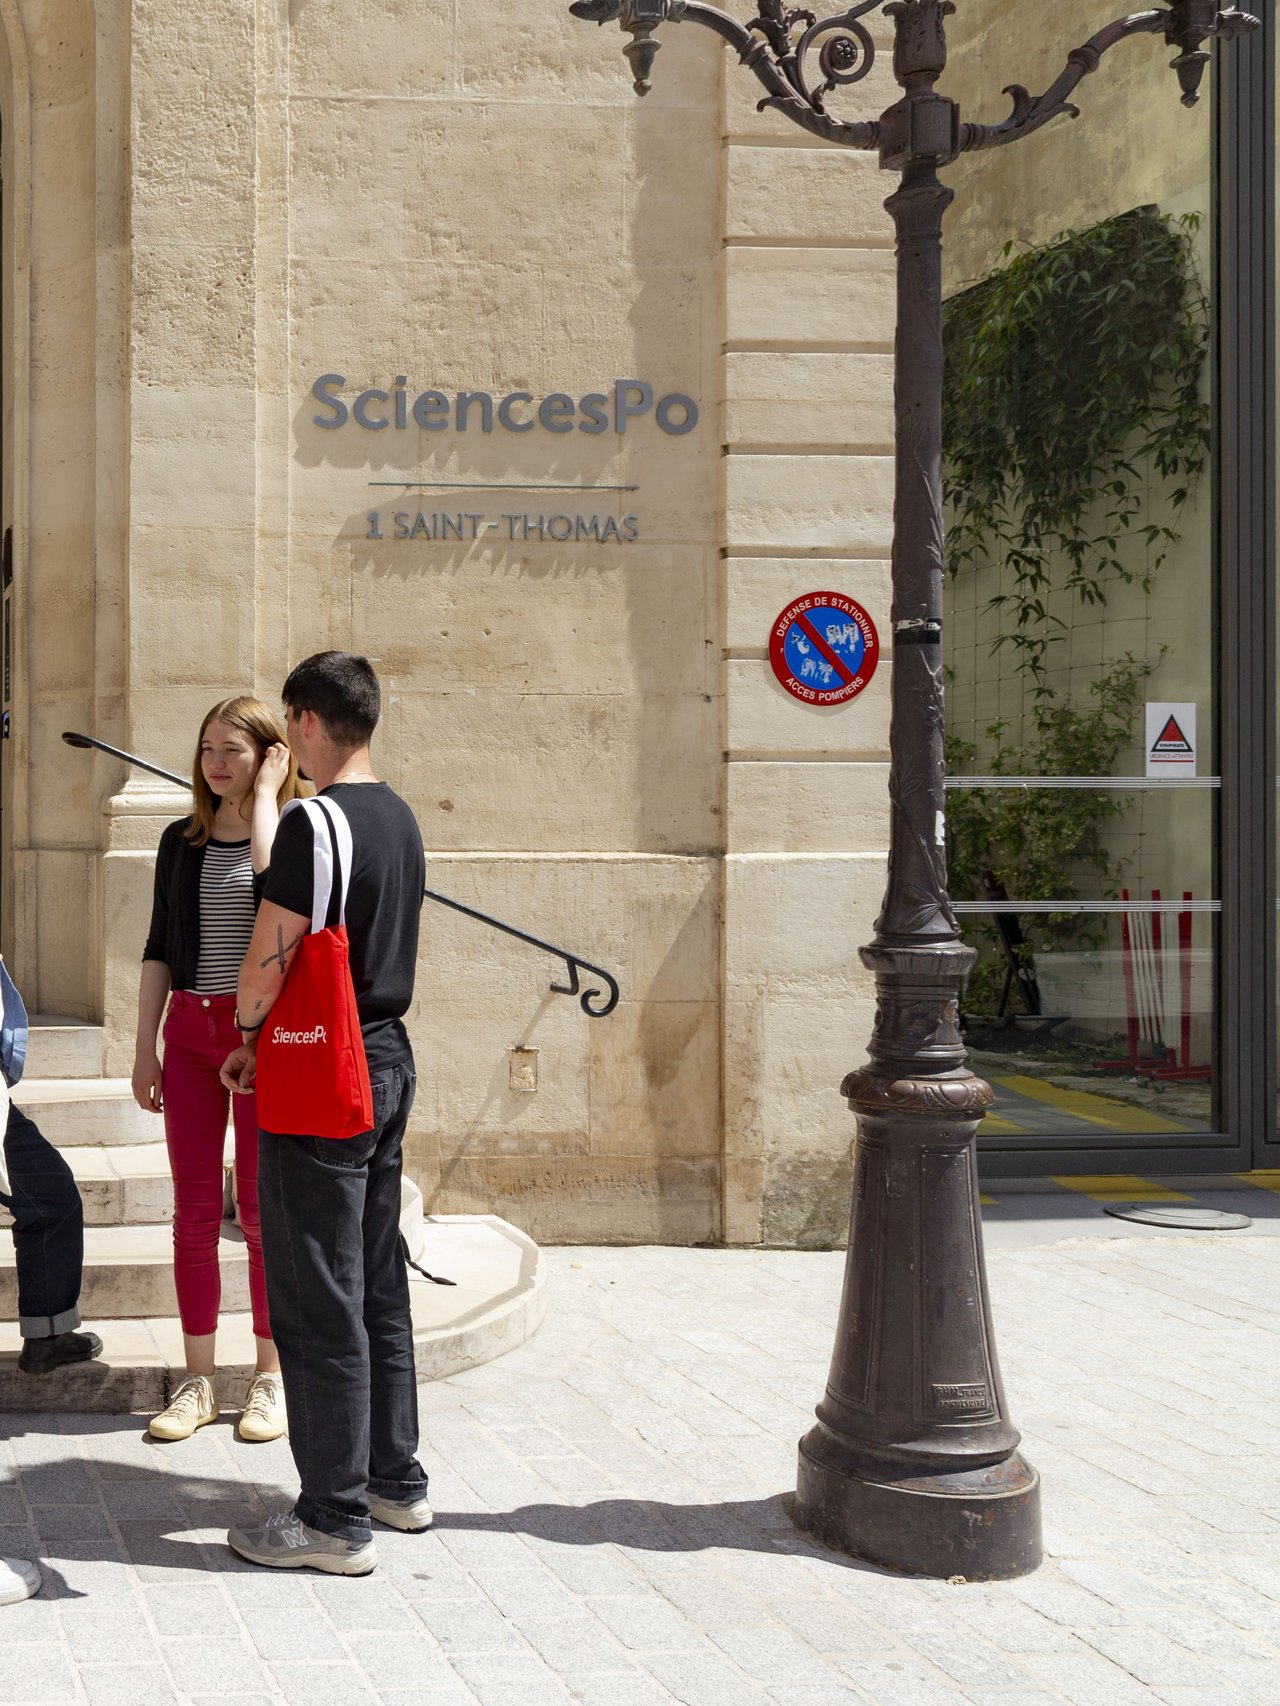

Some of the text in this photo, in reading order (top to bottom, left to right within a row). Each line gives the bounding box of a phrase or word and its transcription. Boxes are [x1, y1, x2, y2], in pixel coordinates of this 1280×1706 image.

[312, 373, 699, 436] SciencesPo
[366, 511, 641, 543] 1 SAINT-THOMAS
[776, 596, 874, 648] DEFENSE DE STATIONNER
[785, 676, 864, 702] ACCES POMPIERS
[281, 1526, 309, 1549] N
